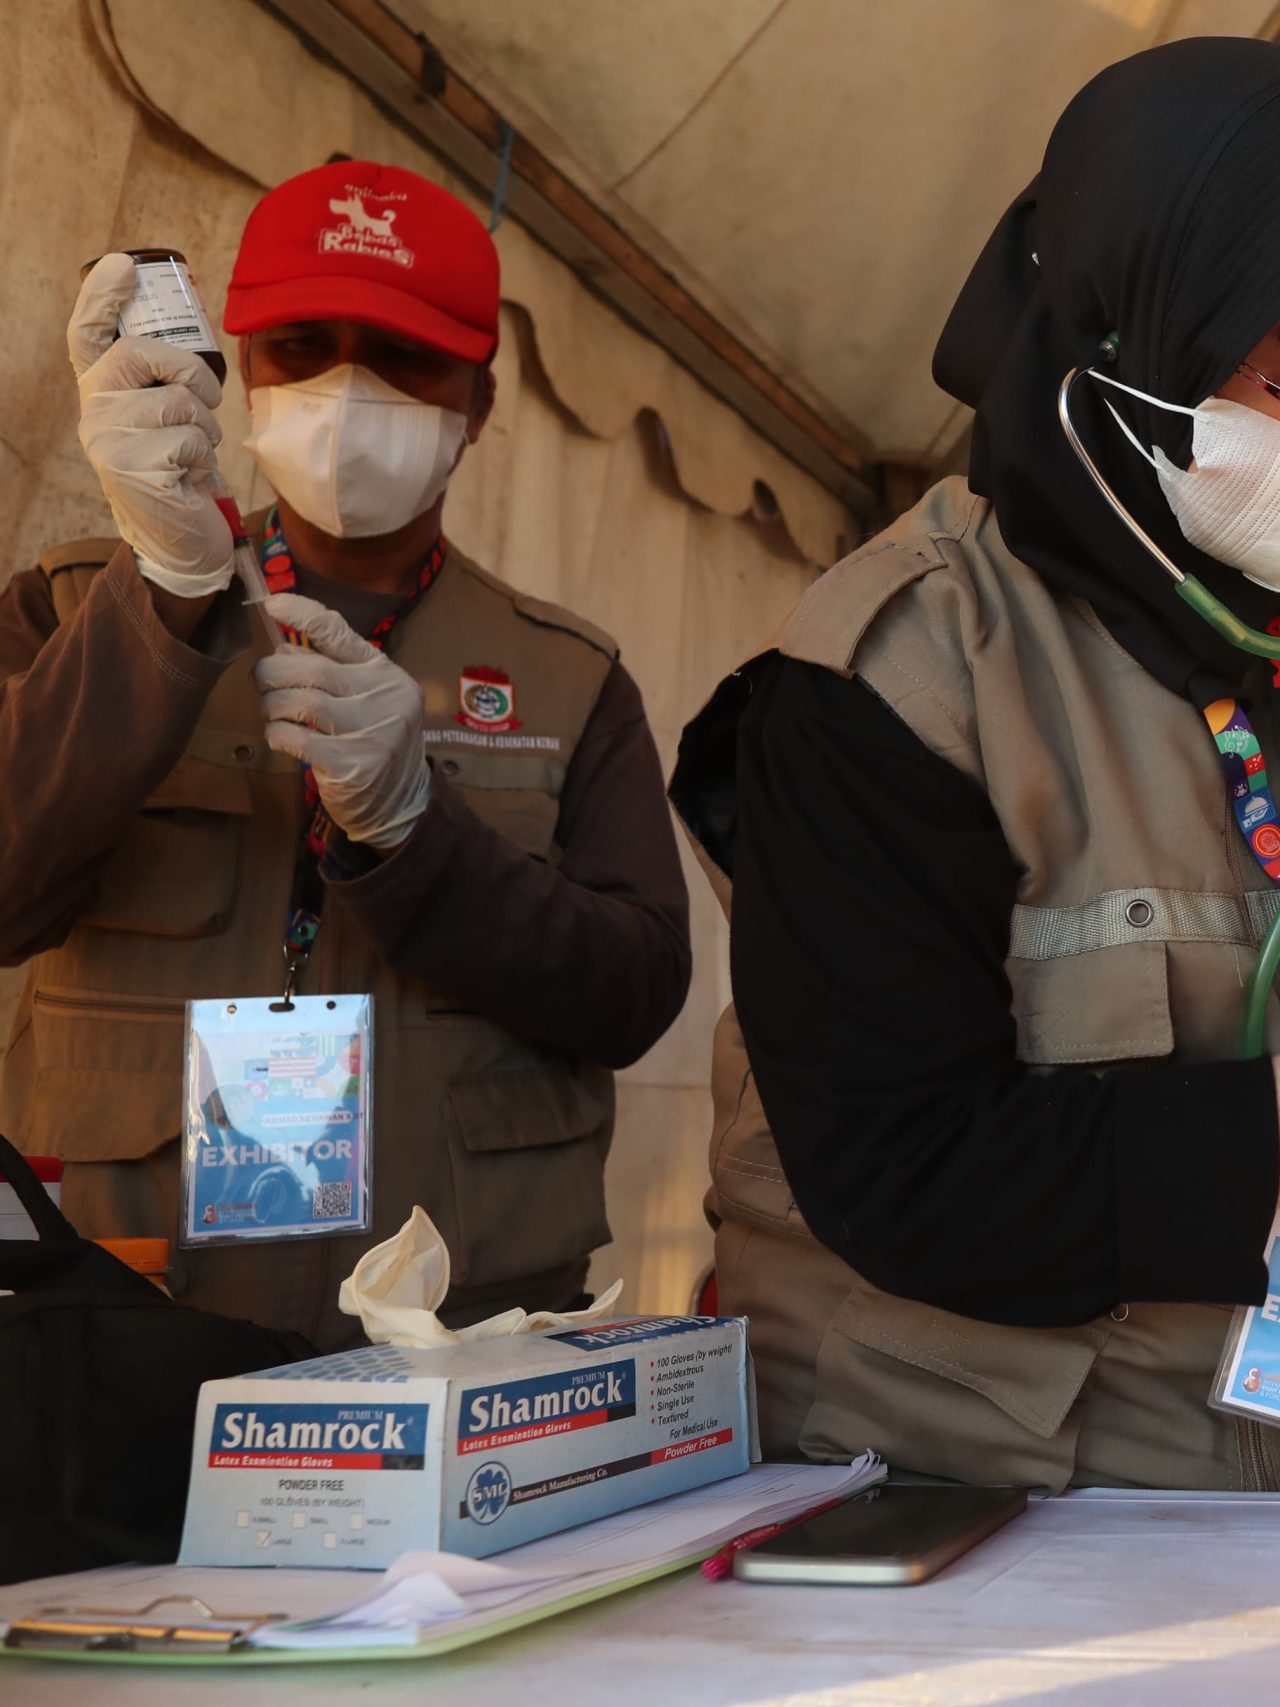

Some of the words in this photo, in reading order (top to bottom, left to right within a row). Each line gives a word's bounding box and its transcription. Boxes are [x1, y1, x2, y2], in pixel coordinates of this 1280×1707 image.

[202, 1139, 353, 1168] EXHIBITOR
[657, 1357, 670, 1369] 100
[671, 1353, 695, 1366] Gloves
[696, 1350, 707, 1361] (by
[708, 1343, 733, 1358] weight)
[572, 1371, 605, 1384] PREMIUM
[656, 1364, 704, 1383] Ambidextrous
[656, 1380, 695, 1397] Non-Sterile
[469, 1371, 623, 1433] Shamrock
[657, 1399, 680, 1412] Single
[681, 1394, 695, 1406] Use
[337, 1410, 384, 1421] PREMIUM
[658, 1409, 689, 1426] Textured
[221, 1412, 406, 1450] Shamrock
[463, 1439, 489, 1452] Latex
[491, 1427, 544, 1446] Examination
[545, 1421, 571, 1435] Gloves
[670, 1428, 681, 1441] For
[682, 1420, 706, 1436] Medical
[706, 1417, 719, 1429] Use
[664, 1443, 697, 1460] Powder
[699, 1436, 718, 1450] Free
[214, 1455, 241, 1467] Latex
[242, 1455, 299, 1467] Examination
[300, 1456, 334, 1468] Gloves
[278, 1479, 319, 1492] POWDER
[320, 1480, 345, 1492] FREE
[513, 1484, 549, 1501] Shamrock
[549, 1471, 597, 1492] Manufacturing
[275, 1496, 310, 1507] GLOVES
